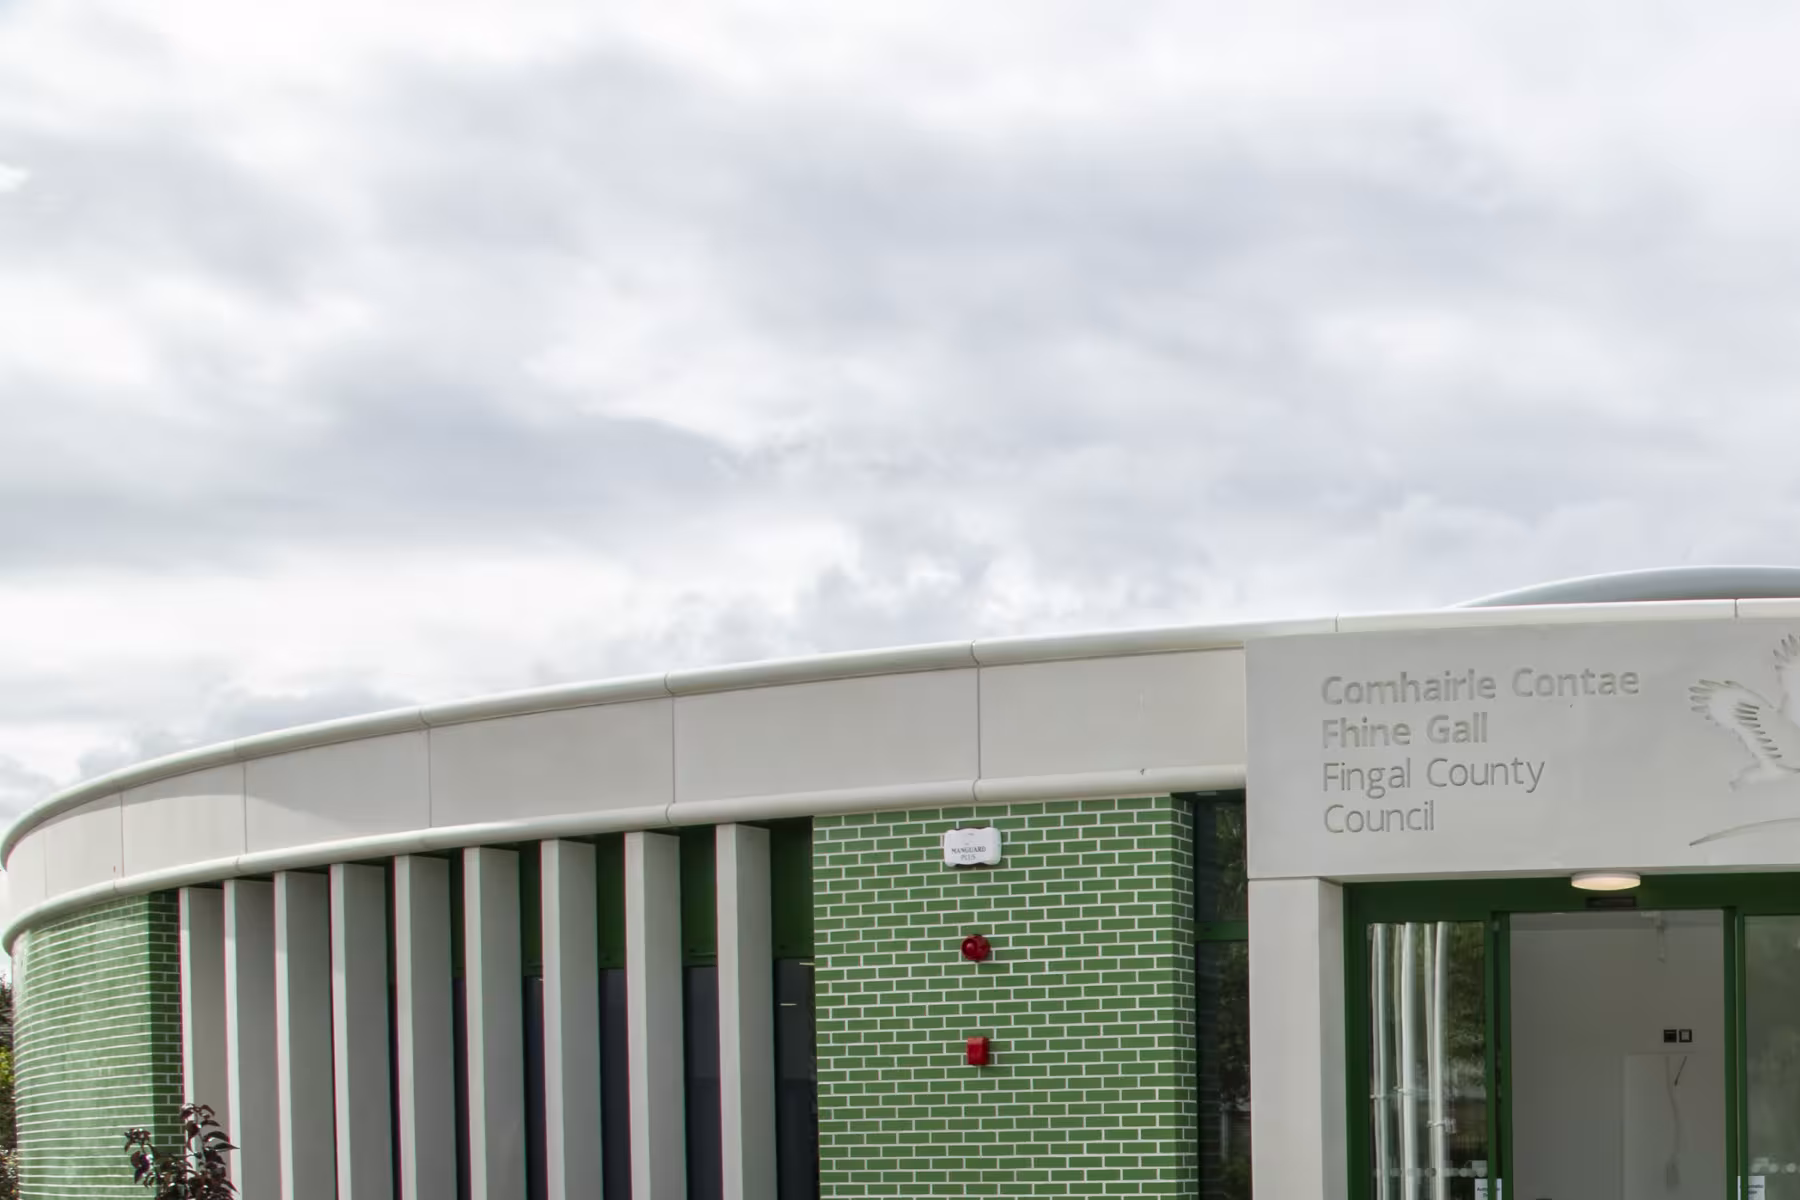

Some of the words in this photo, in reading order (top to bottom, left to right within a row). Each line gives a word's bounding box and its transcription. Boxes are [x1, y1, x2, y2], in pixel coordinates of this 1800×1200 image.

[1320, 668, 1497, 706] Comhairle
[1511, 666, 1640, 698] Contae
[1321, 716, 1412, 749] Fhine
[1426, 711, 1488, 745] Gall
[1322, 757, 1411, 800] Fingal
[1426, 756, 1546, 794] County
[1322, 800, 1435, 834] Council
